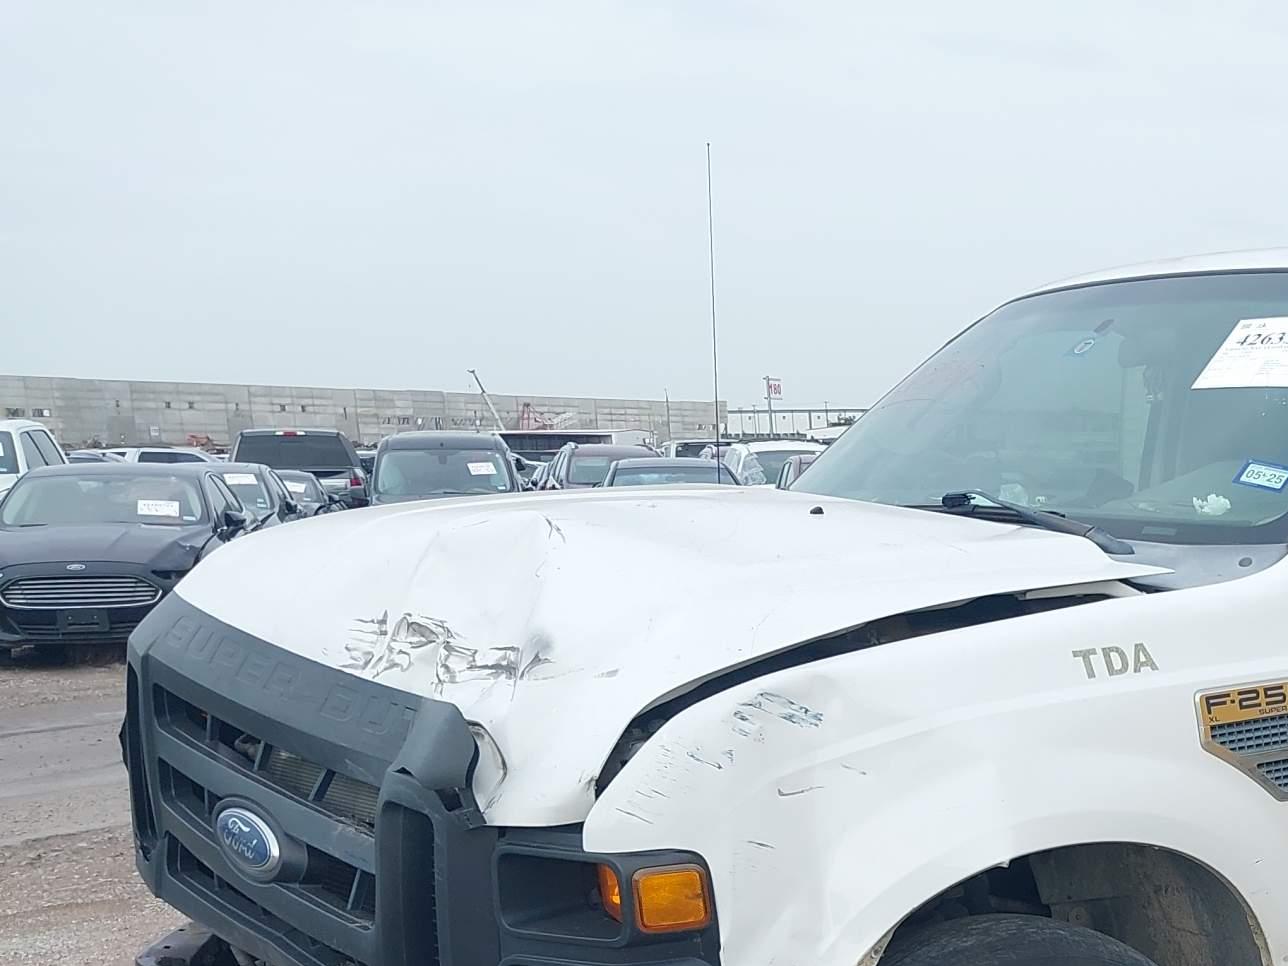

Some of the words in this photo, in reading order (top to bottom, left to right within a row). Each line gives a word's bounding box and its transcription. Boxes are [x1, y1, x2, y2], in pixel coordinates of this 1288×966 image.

[1245, 469, 1264, 480] 05
[1266, 472, 1286, 484] 25
[1072, 642, 1160, 680] TDA
[164, 614, 298, 700] SUPER
[318, 681, 418, 748] DUT
[1258, 705, 1288, 715] SUPER
[222, 817, 258, 859] Ford
